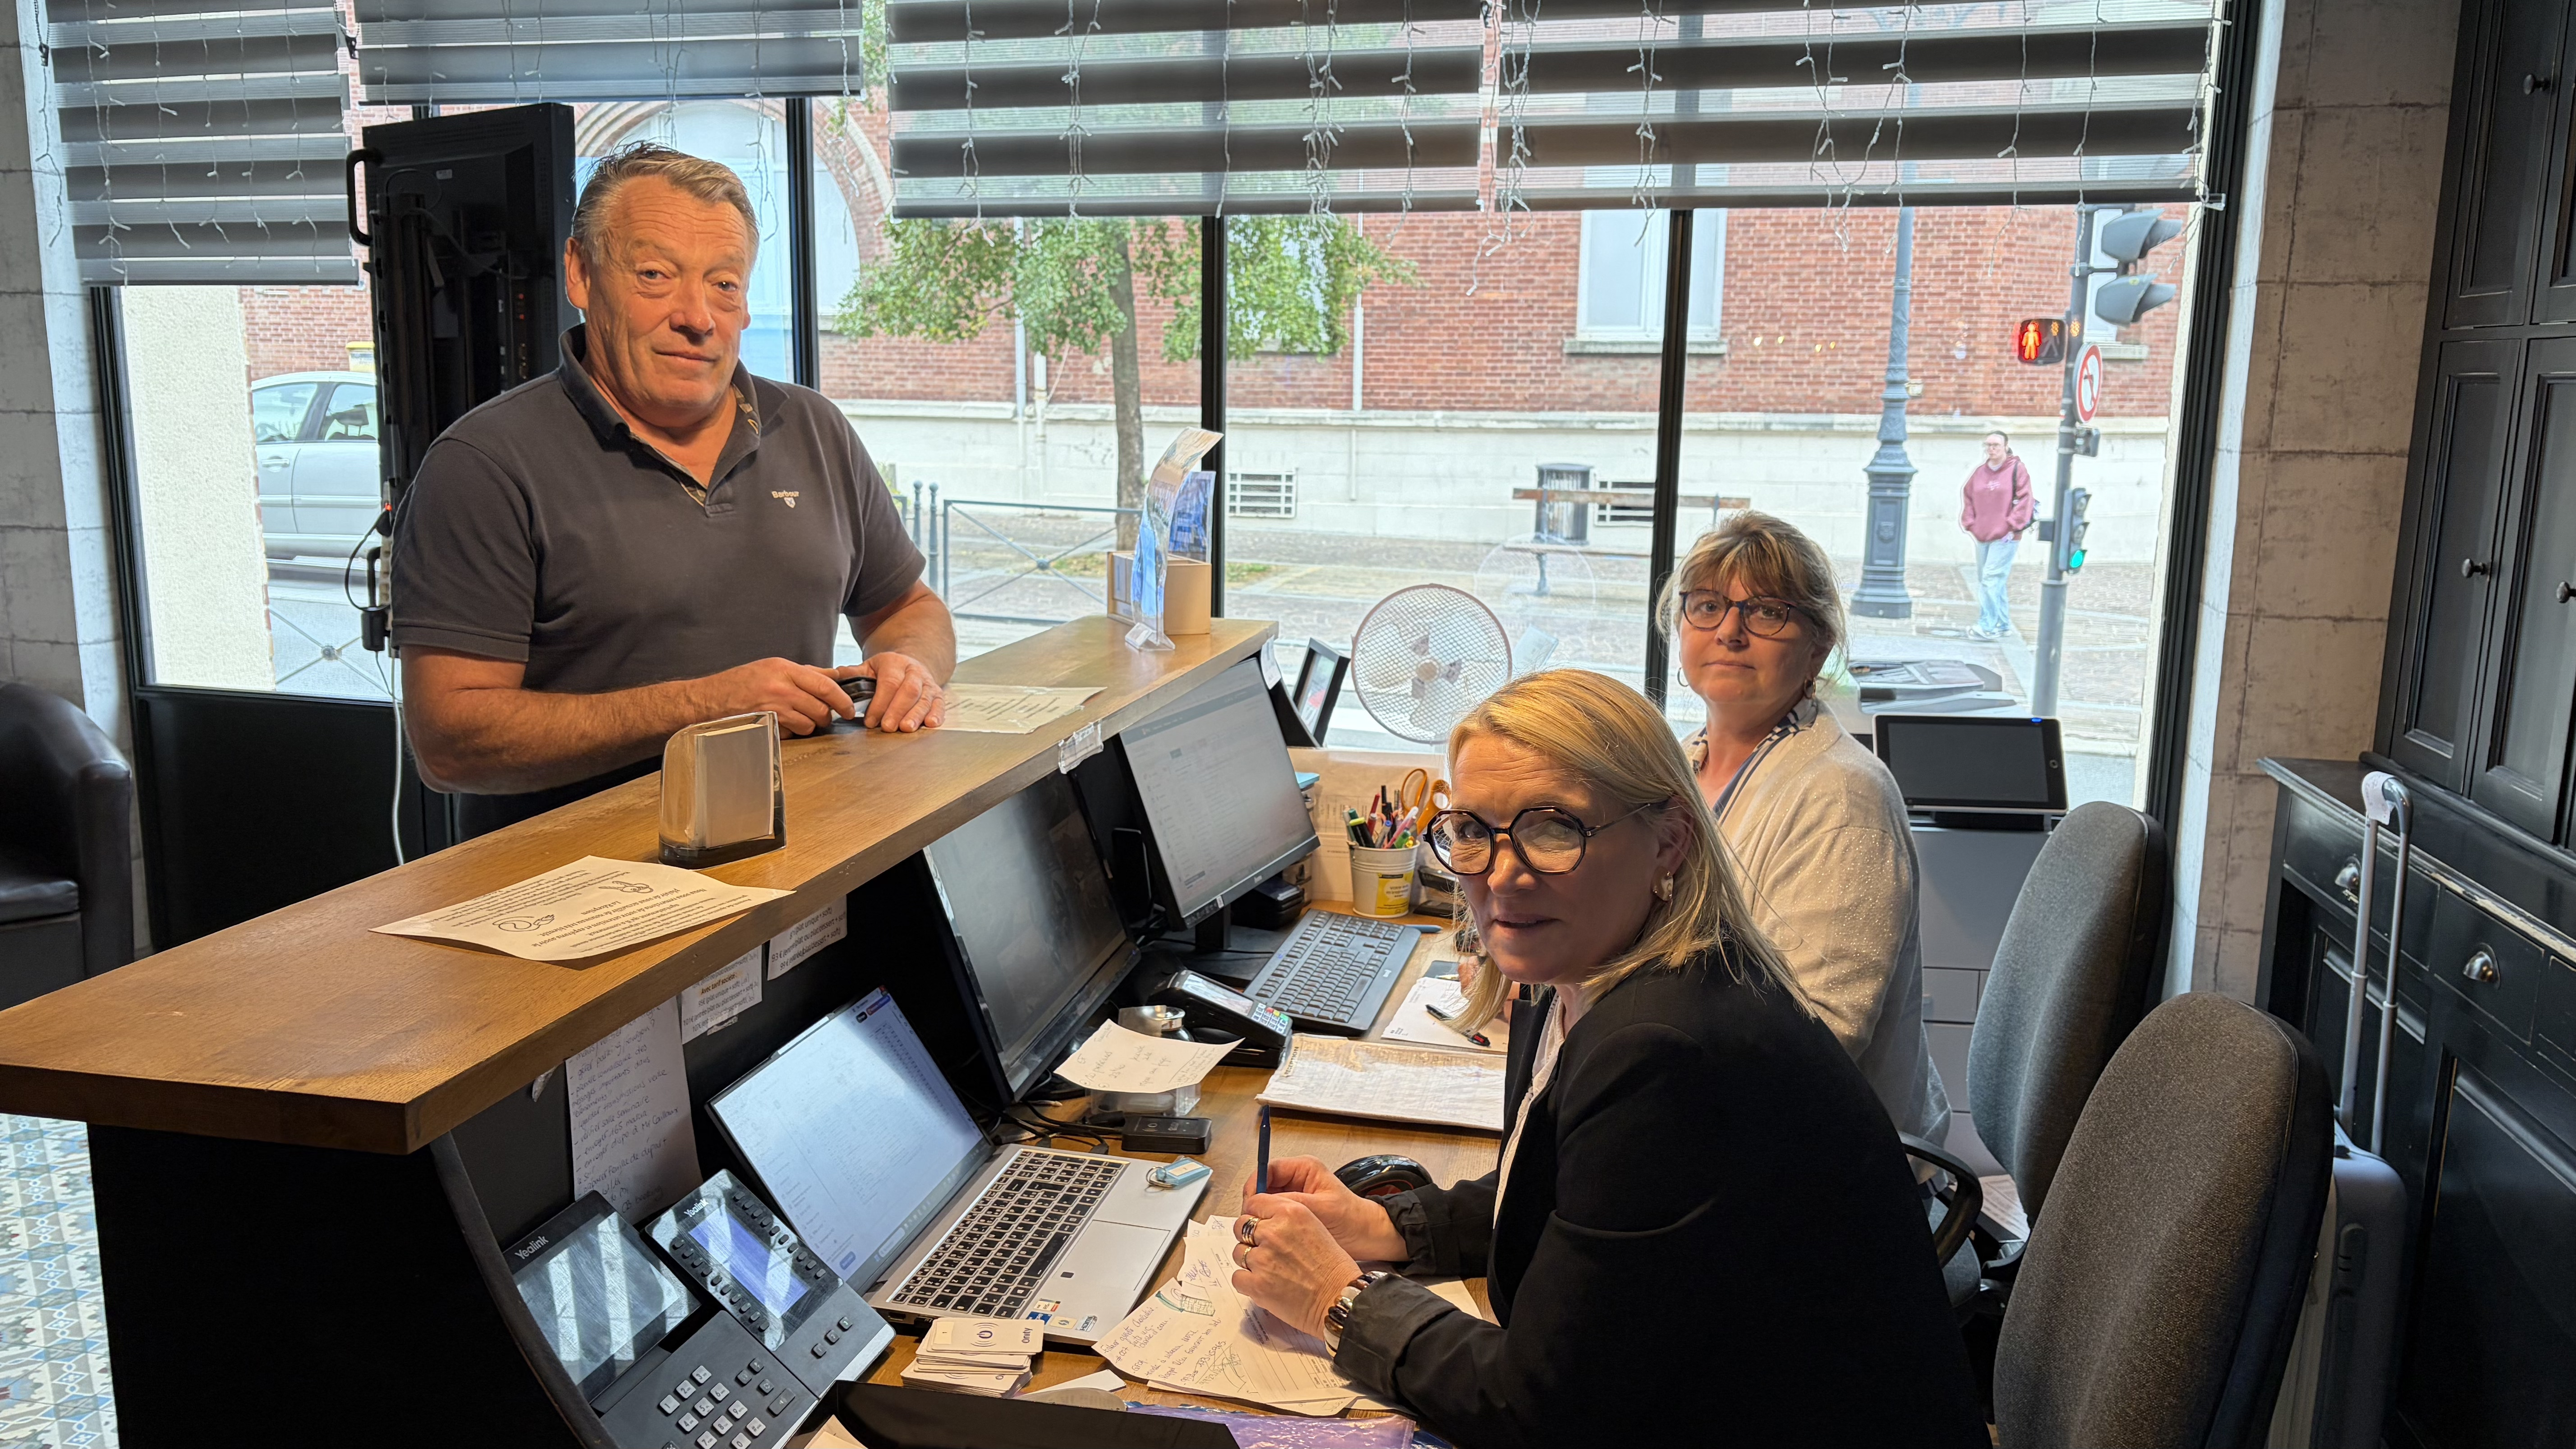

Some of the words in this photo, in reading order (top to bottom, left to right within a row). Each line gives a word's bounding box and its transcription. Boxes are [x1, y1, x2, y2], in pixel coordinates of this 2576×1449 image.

[1284, 1046, 1299, 1076] RECEPTION
[684, 1198, 709, 1218] Yealink
[515, 1234, 549, 1260] Yealink
[1021, 1327, 1033, 1343] Onity
